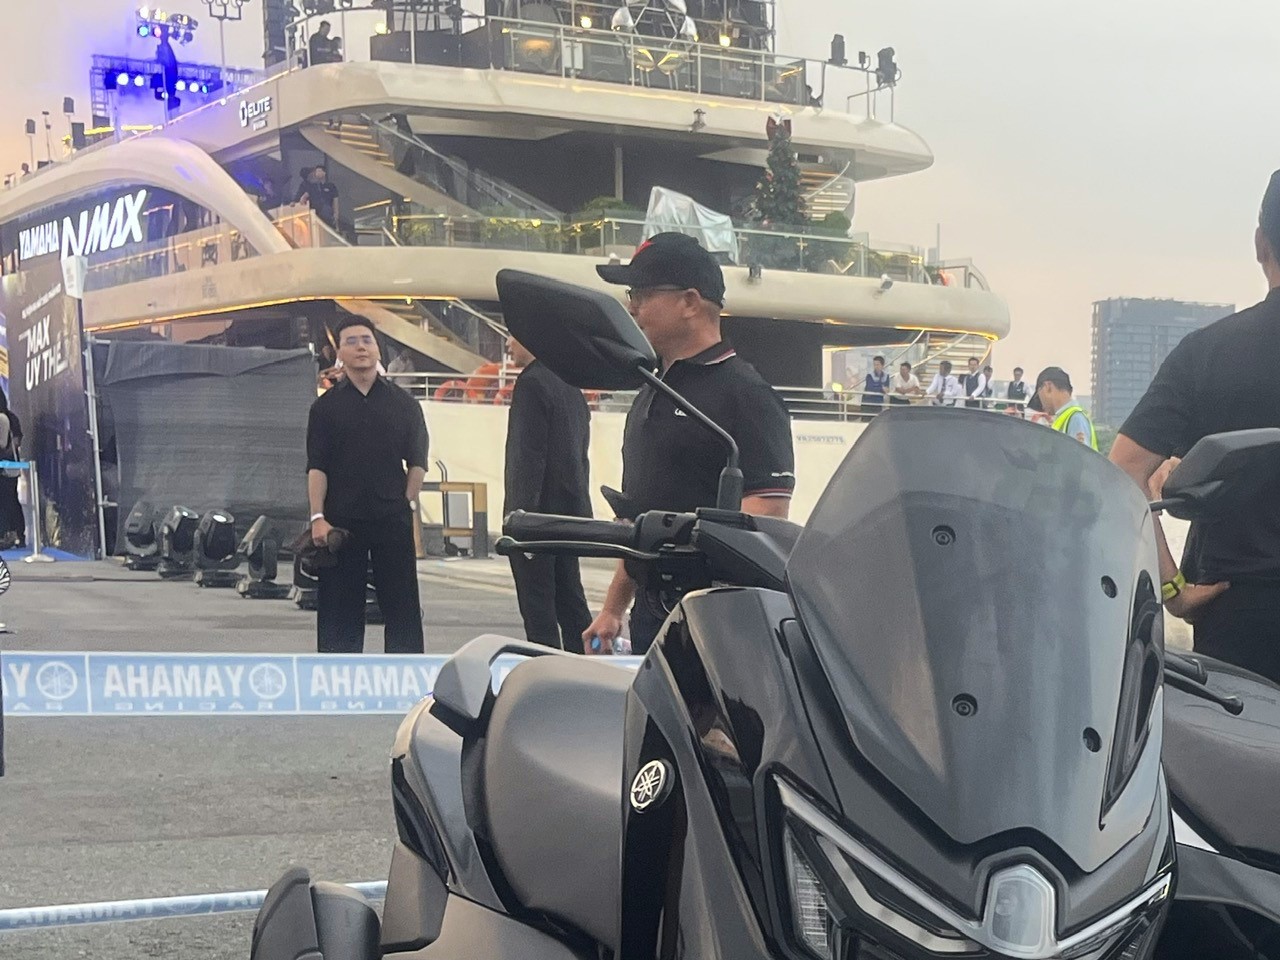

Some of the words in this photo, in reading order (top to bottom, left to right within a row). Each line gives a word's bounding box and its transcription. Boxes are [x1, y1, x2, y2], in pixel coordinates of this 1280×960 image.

[19, 220, 60, 260] YAMAHA
[61, 189, 147, 259] NMAX
[20, 314, 51, 358] MAX
